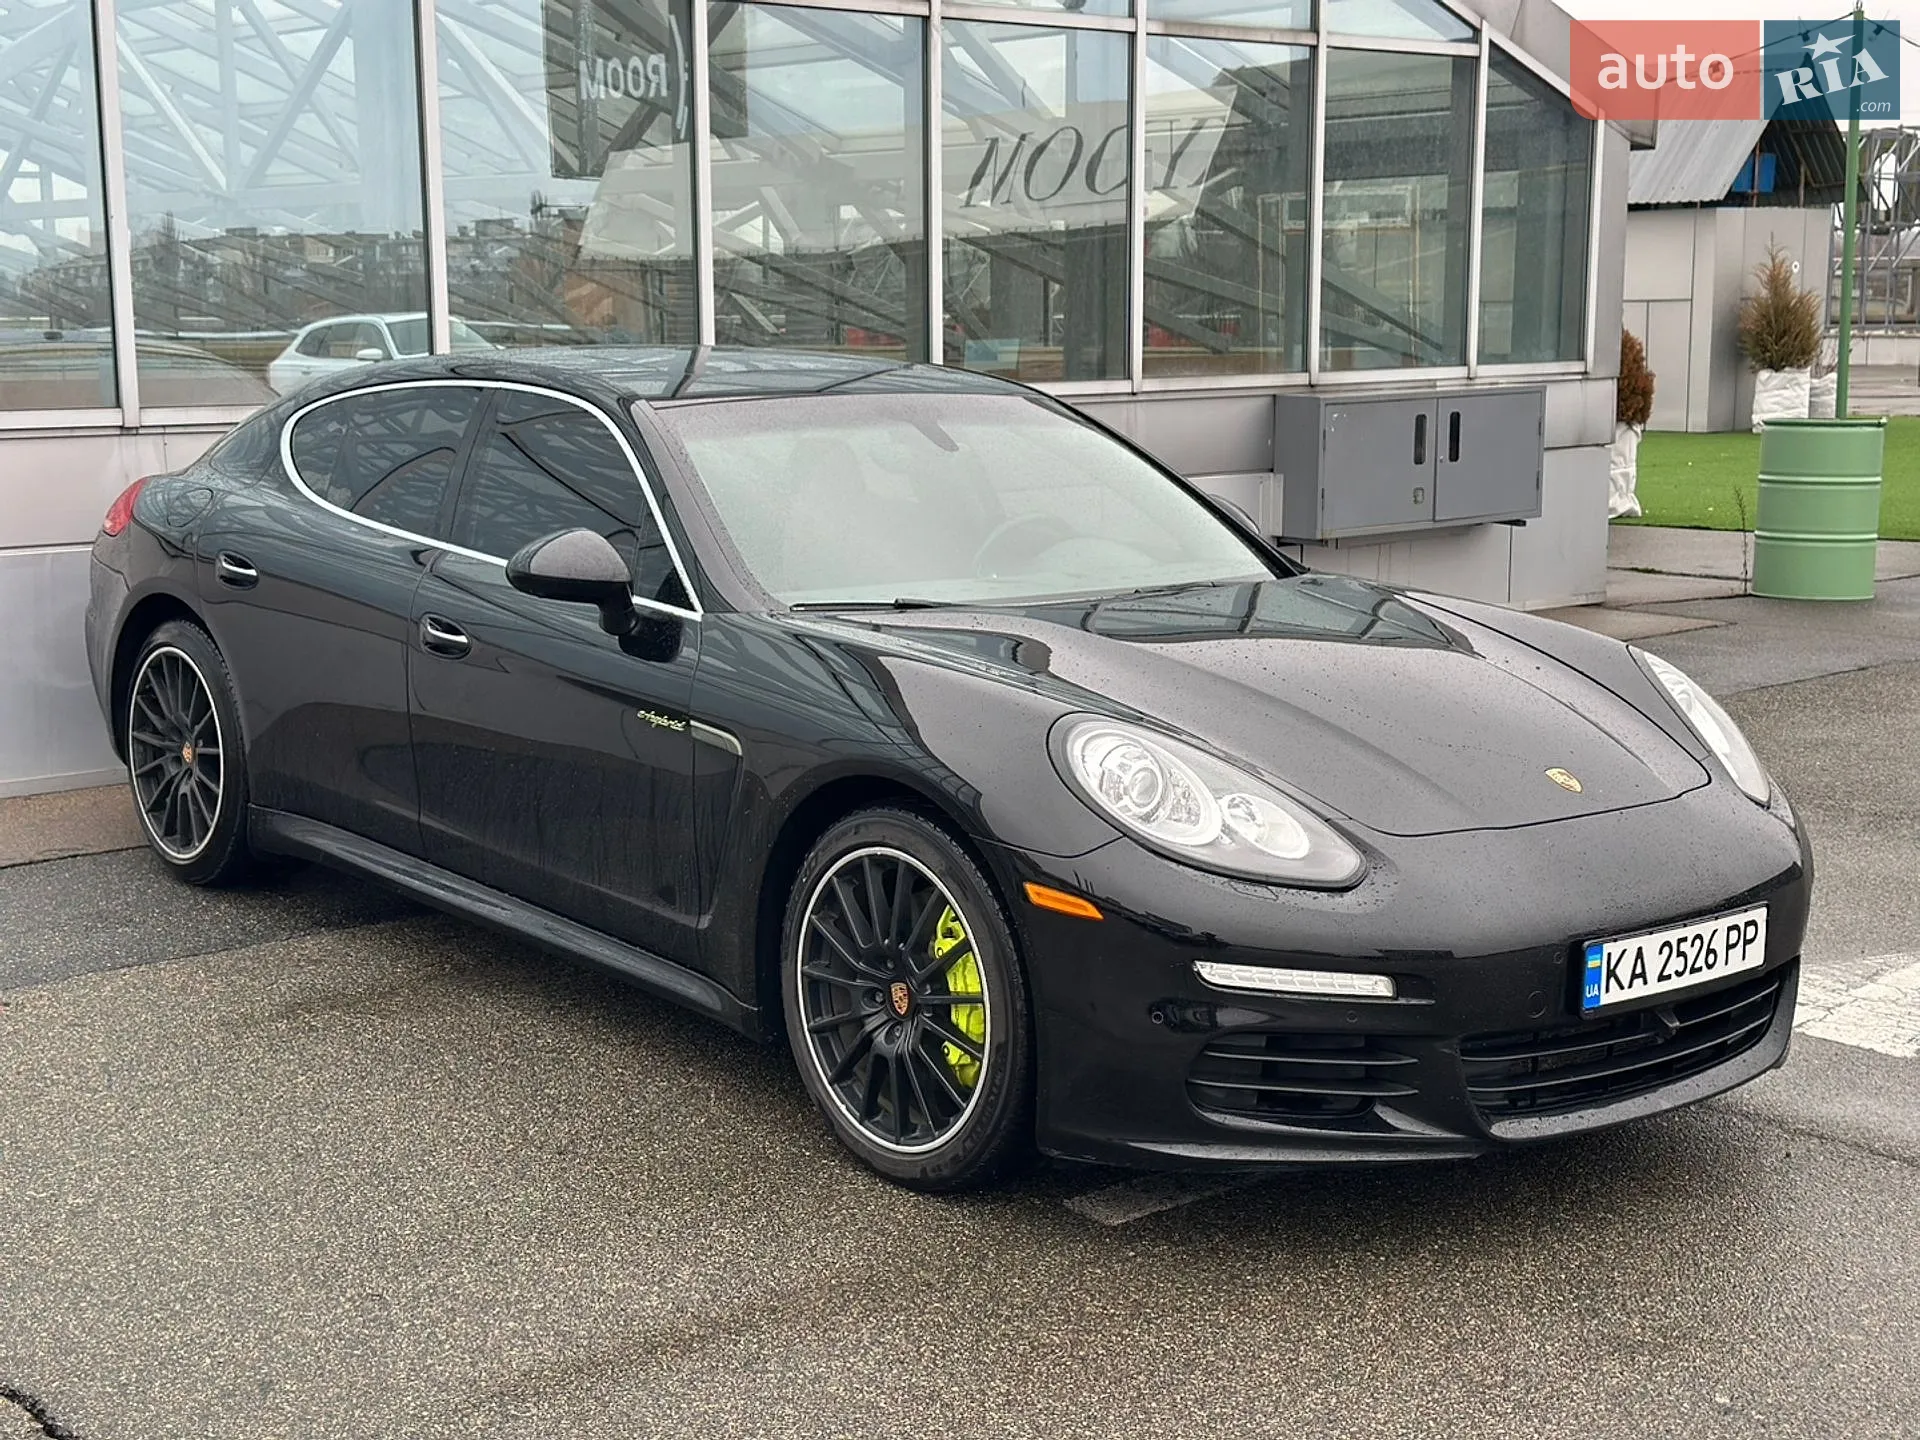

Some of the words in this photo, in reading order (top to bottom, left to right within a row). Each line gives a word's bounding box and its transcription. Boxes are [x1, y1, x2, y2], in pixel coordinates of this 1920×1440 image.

[1605, 946, 1648, 994] KA
[1656, 928, 1719, 983] 2526
[1725, 918, 1759, 966] PP
[1585, 982, 1600, 998] UA
